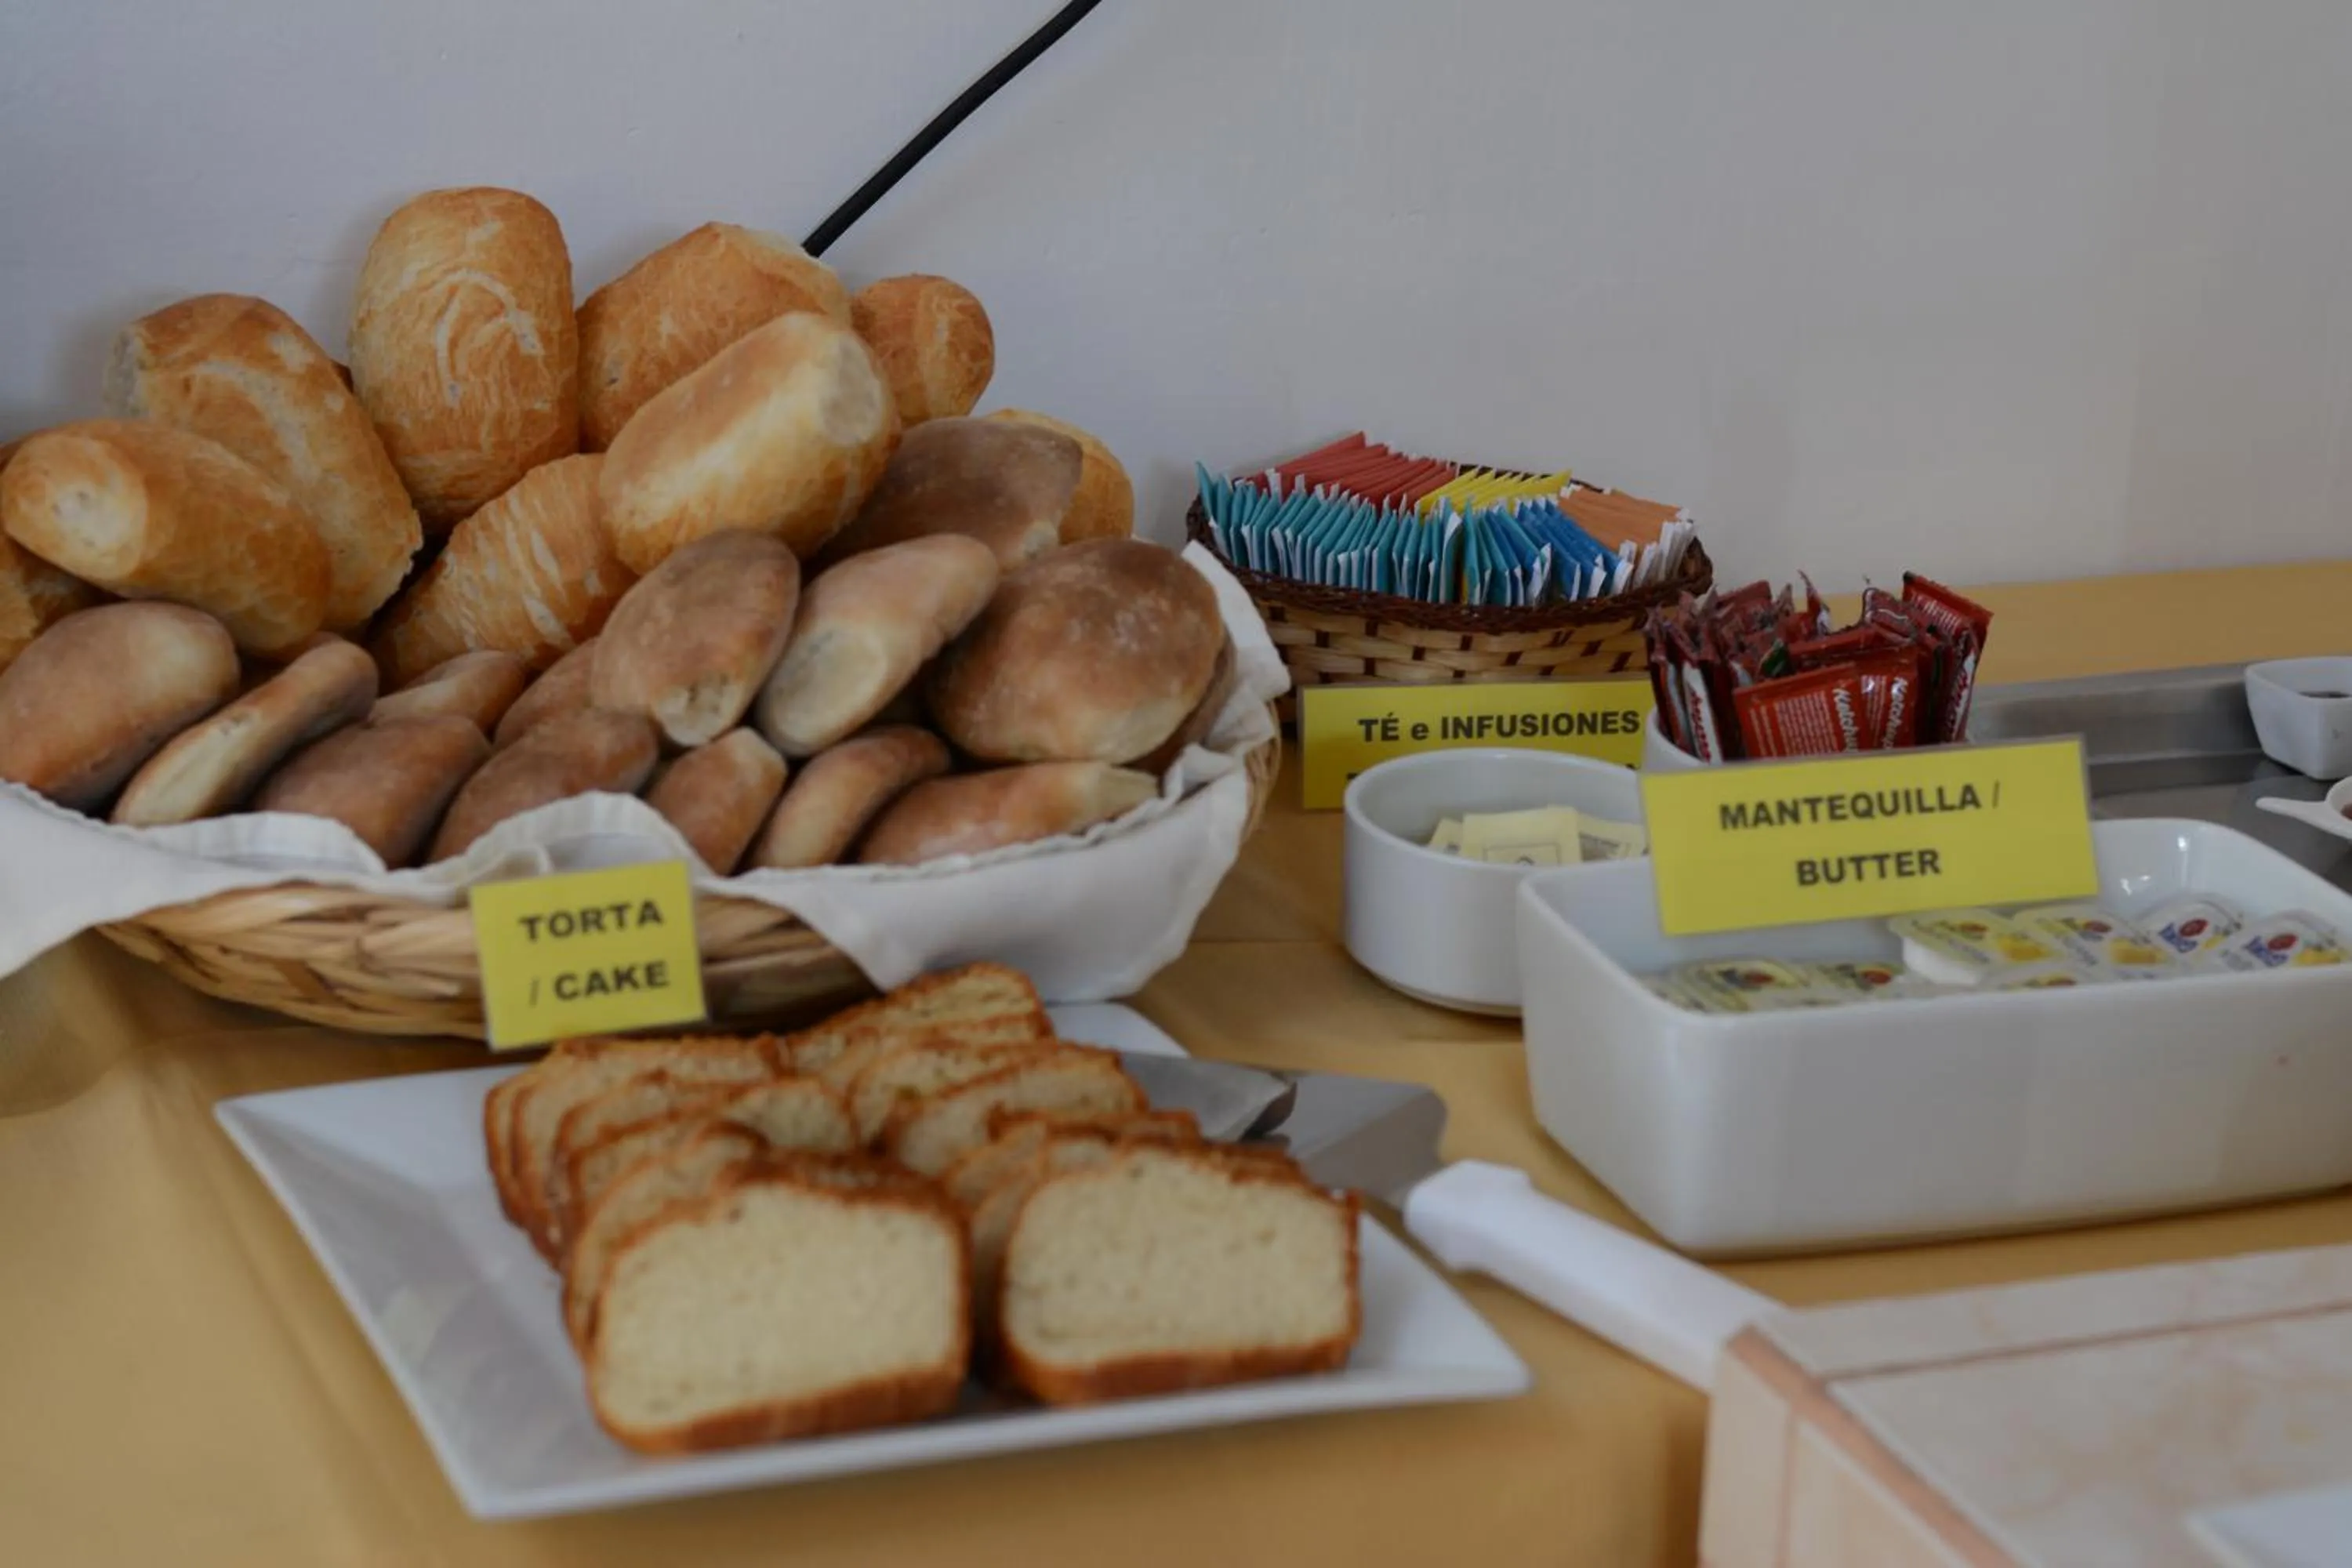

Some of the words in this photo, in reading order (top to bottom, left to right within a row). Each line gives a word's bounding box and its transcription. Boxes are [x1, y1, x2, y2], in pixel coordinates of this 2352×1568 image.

[1358, 713, 1400, 742] TÉ
[1411, 721, 1430, 741] e
[1441, 710, 1641, 740] INFUSIONES
[1719, 782, 1981, 830] MANTEQUILLA
[1796, 848, 1942, 887] BUTTER
[518, 898, 663, 943] TORTA
[554, 960, 669, 1001] CAKE
